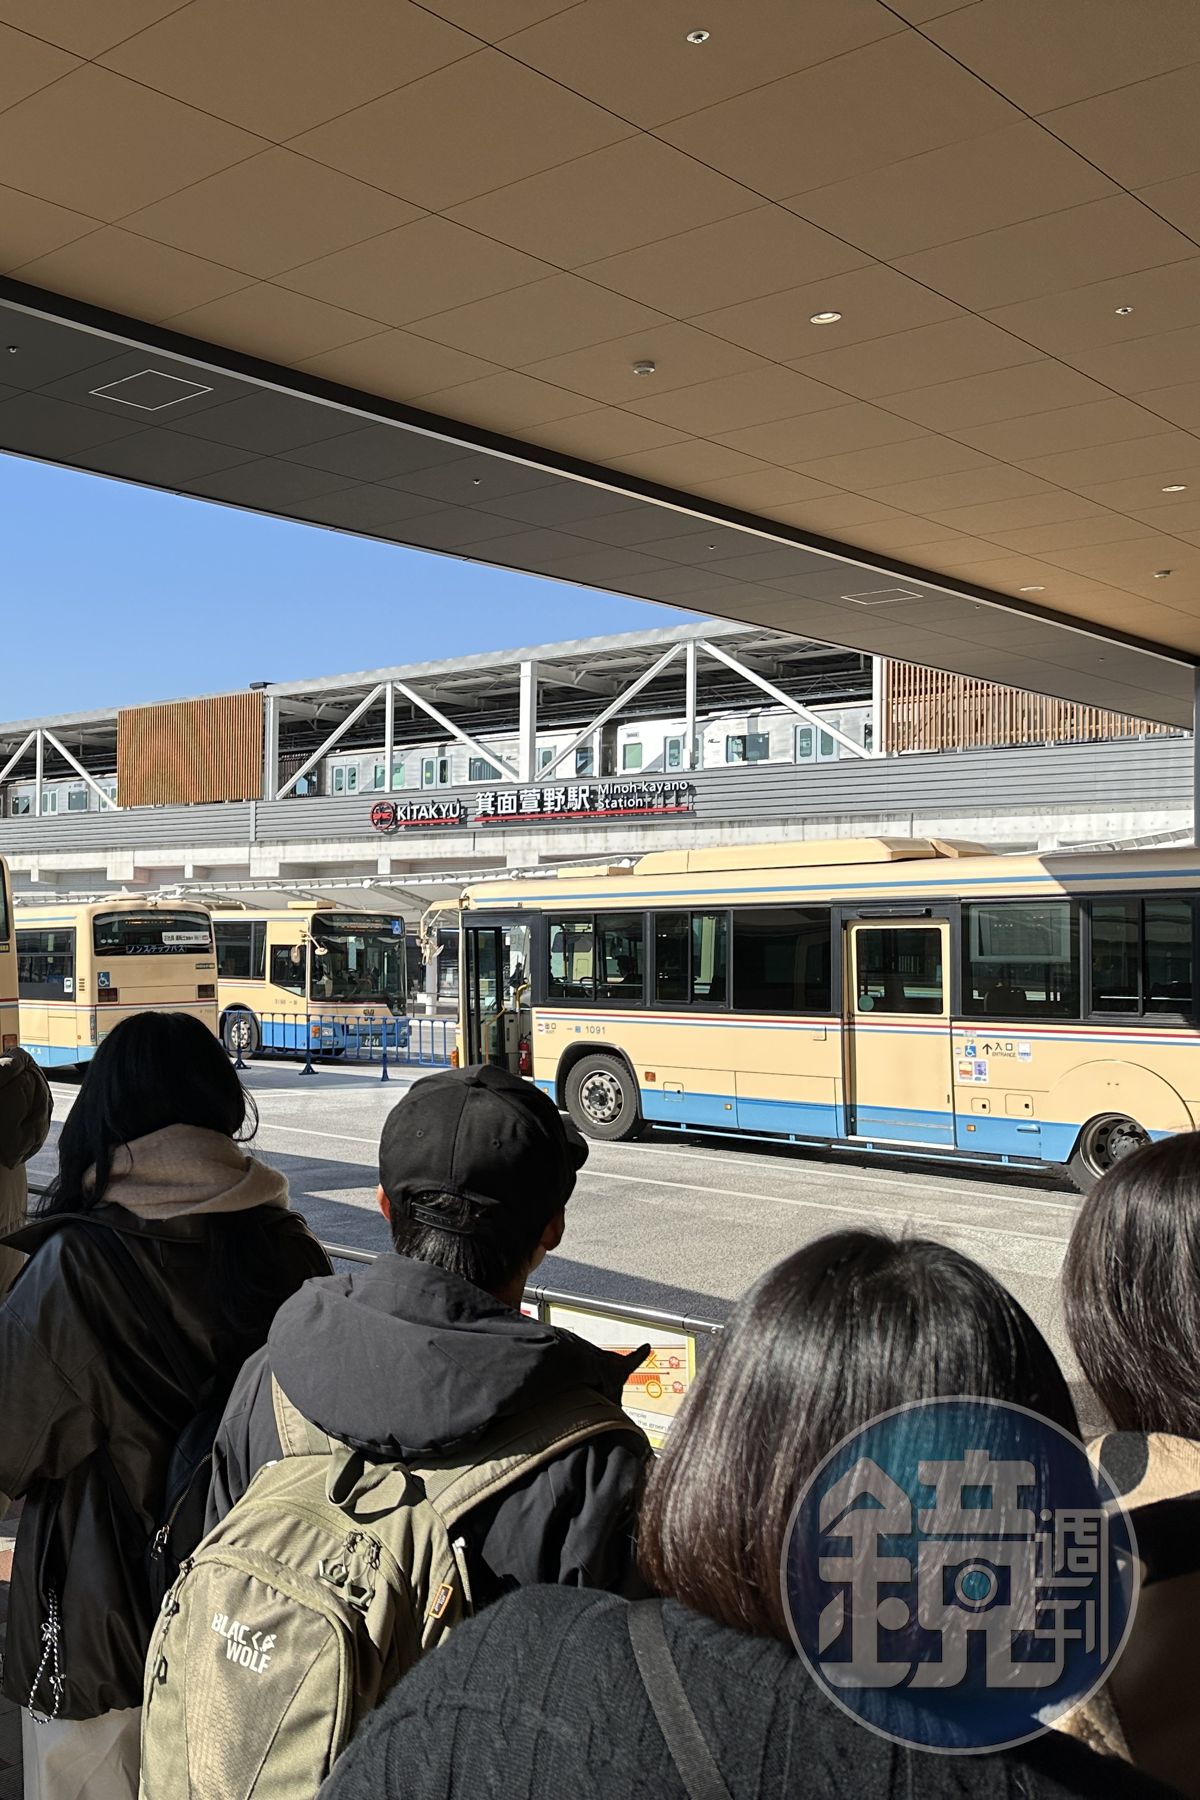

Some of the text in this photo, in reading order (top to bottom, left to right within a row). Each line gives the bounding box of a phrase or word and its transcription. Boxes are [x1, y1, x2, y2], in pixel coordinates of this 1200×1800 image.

[598, 781, 687, 794] Minoh-kayano
[475, 786, 590, 815] 箕面萱野駅
[598, 797, 643, 809] Station
[397, 803, 460, 820] KITAKYU
[585, 1025, 606, 1034] 1091
[994, 1042, 1013, 1051] 入口
[226, 1639, 272, 1674] WOLF
